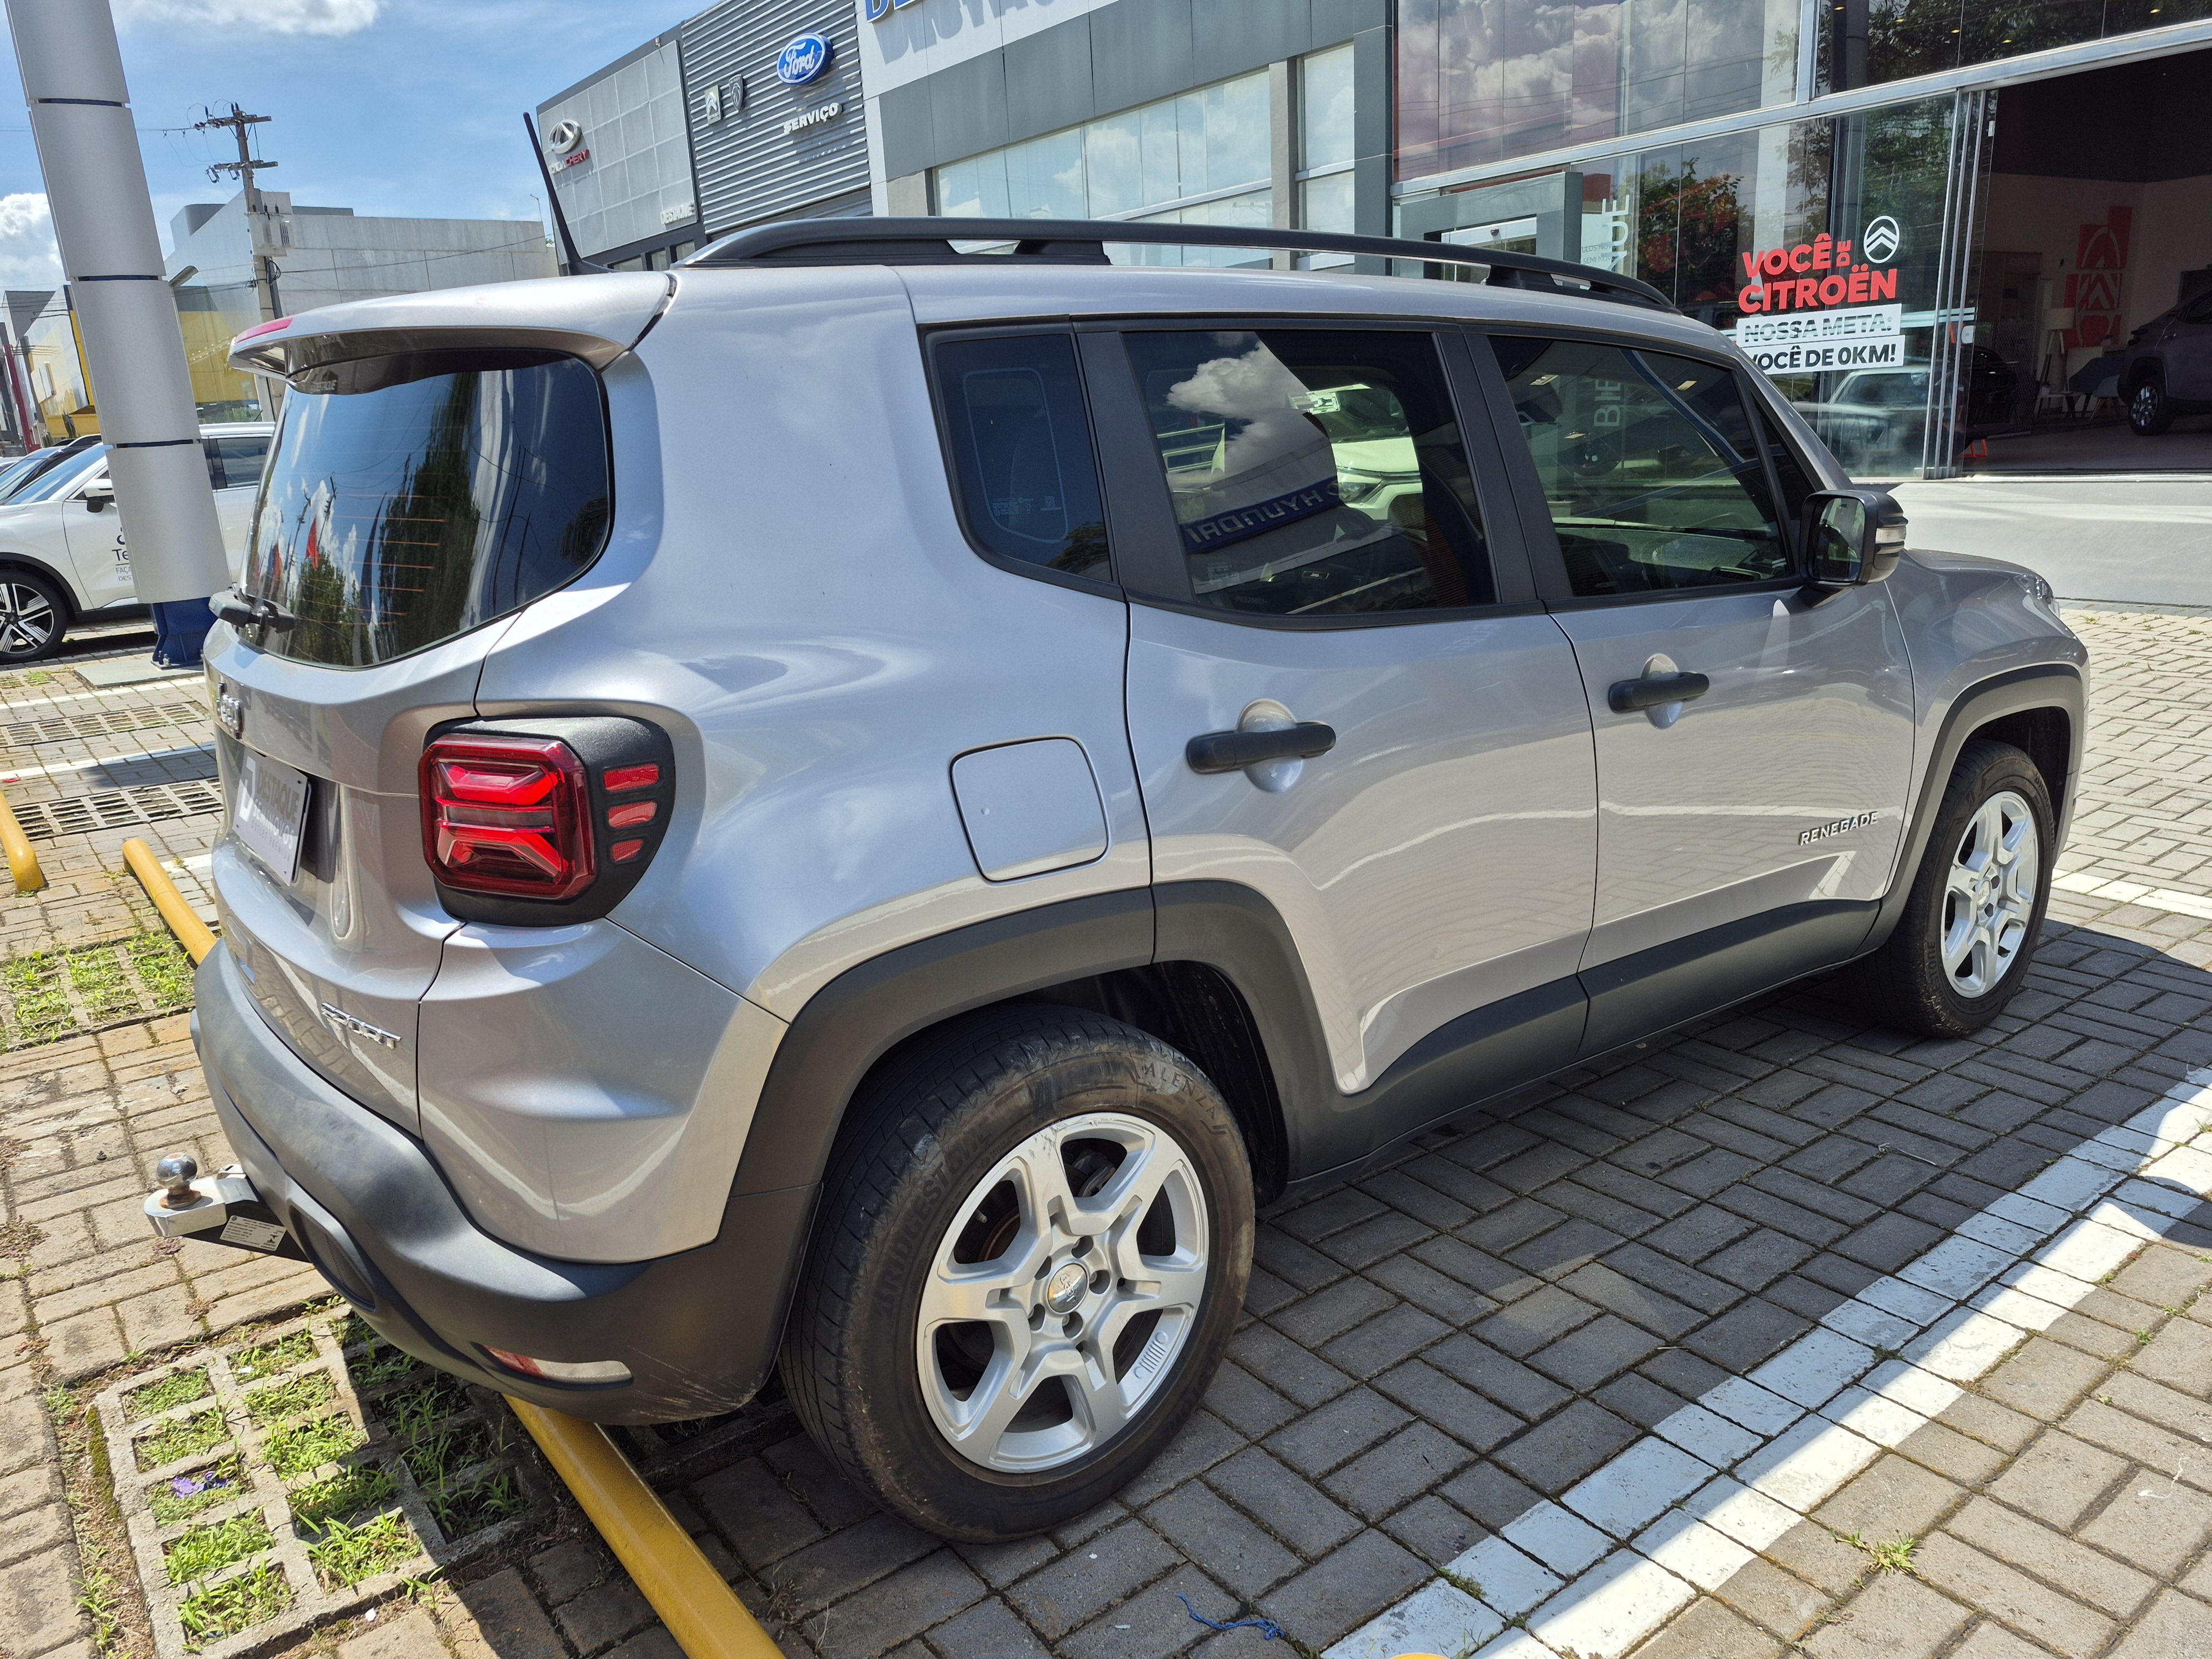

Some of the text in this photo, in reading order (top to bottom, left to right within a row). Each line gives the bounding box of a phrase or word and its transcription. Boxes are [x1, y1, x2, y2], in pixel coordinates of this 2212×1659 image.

[783, 41, 816, 79] Ford
[783, 102, 842, 134] SERVIÇO
[565, 149, 589, 168] CHERY
[1742, 233, 1851, 278] VOCÊ DE
[1738, 263, 1898, 313] CITROËN
[1745, 313, 1893, 342] NOSSA META:
[1805, 348, 1834, 368] DE
[256, 765, 300, 825] DESTAQUE
[1799, 811, 1880, 847] RENEGADE
[321, 1002, 403, 1050] SPORT
[1144, 1062, 1217, 1120] ALENZA
[1059, 1272, 1077, 1304] Jeep
